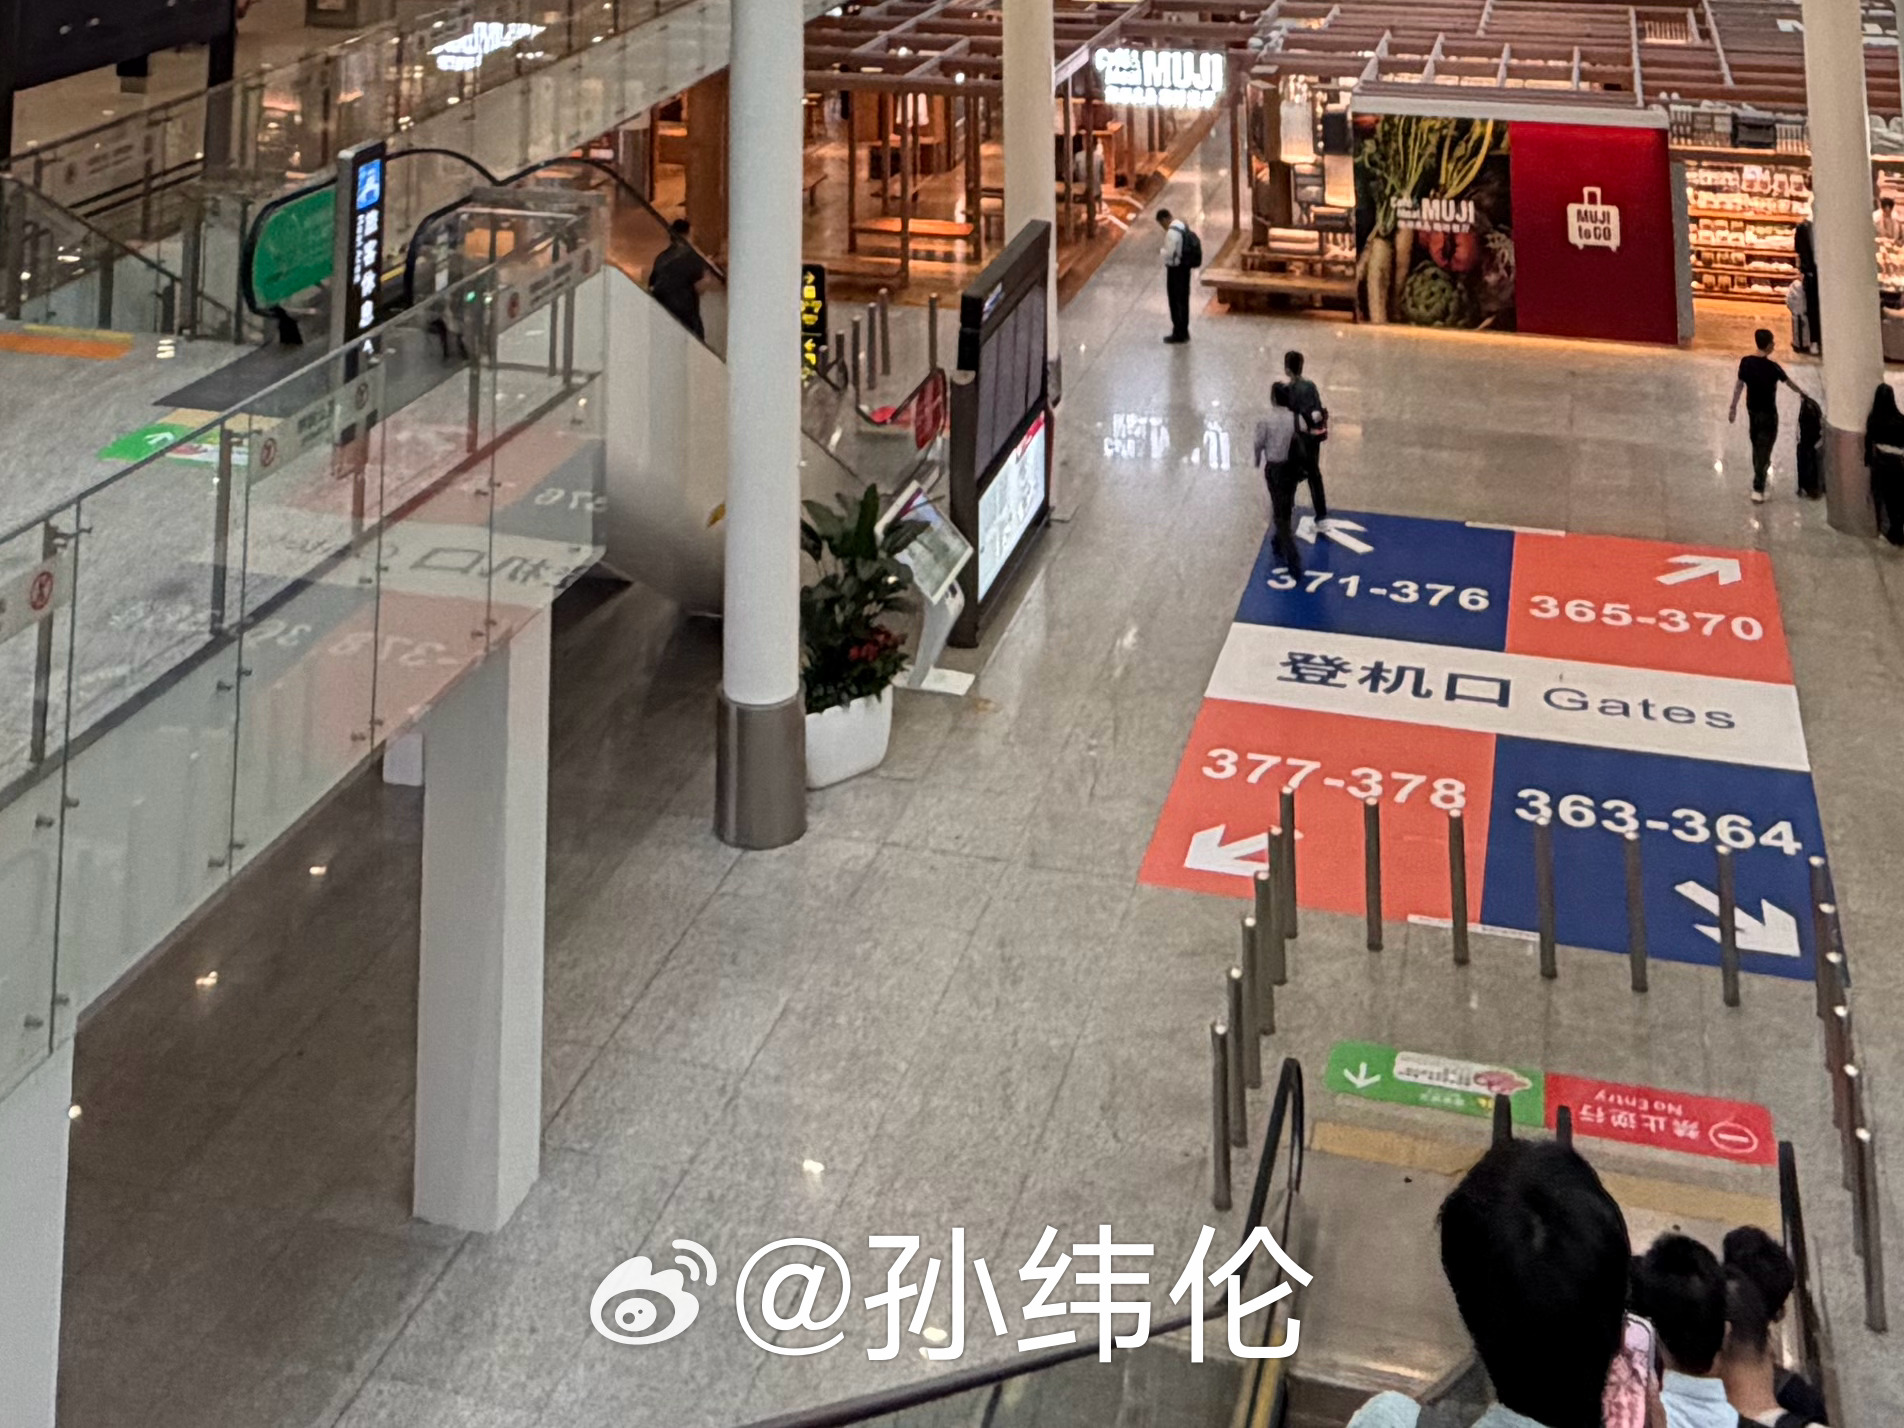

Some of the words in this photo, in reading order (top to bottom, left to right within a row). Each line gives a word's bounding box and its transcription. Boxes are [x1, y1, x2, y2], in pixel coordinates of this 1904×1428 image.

[1142, 50, 1224, 92] MUJI
[1421, 198, 1475, 223] MUJI
[1576, 208, 1611, 224] MUJI
[1578, 225, 1592, 240] to
[1593, 226, 1612, 241] GO
[1267, 566, 1491, 612] 371-376
[1528, 595, 1764, 642] 365-370
[1277, 650, 1511, 709] 登机口
[1542, 687, 1736, 730] Gates
[1201, 748, 1466, 812] 377-378
[1514, 787, 1803, 857] 363-364
[1594, 1088, 1649, 1111] Entry
[1654, 1101, 1683, 1117] No
[1580, 1103, 1700, 1139] 禁止逆行
